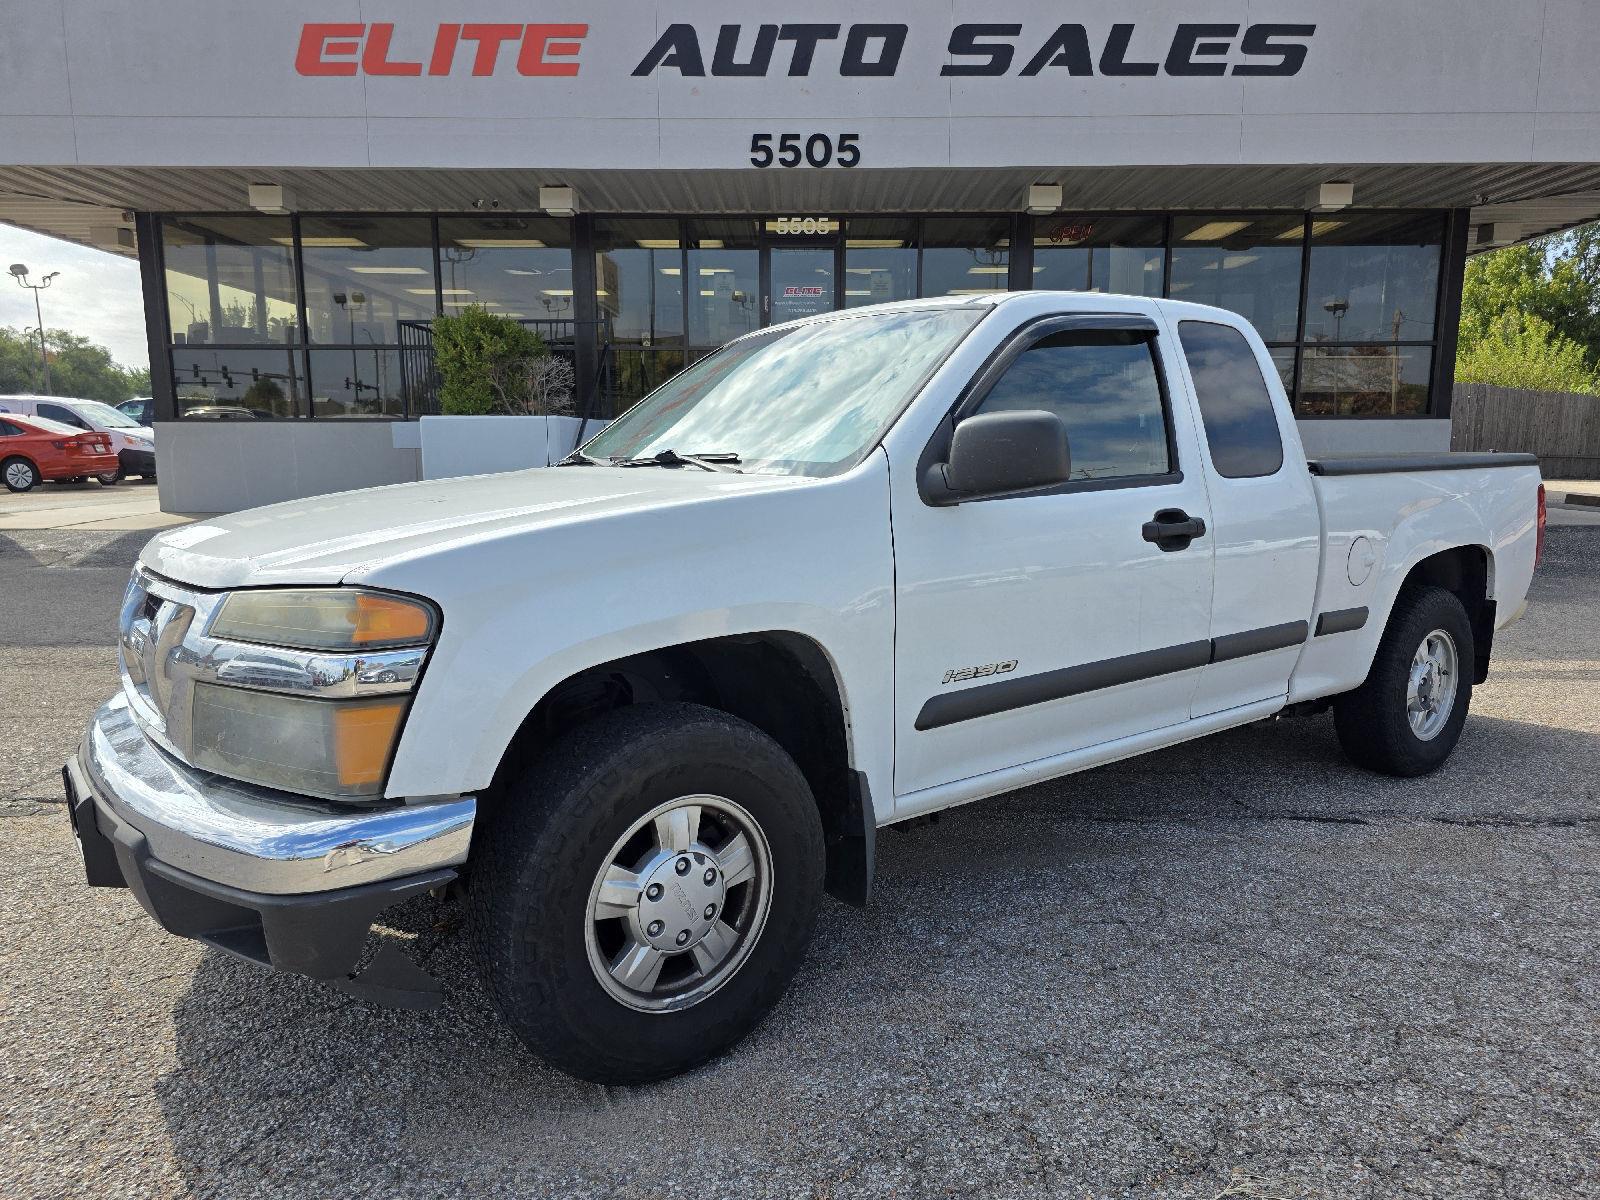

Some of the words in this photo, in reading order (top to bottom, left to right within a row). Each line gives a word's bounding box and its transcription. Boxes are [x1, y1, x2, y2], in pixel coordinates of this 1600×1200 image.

[295, 23, 589, 76] ELITE
[631, 23, 909, 77] AUTO
[940, 23, 1317, 77] SALES
[750, 133, 861, 168] 5505
[776, 217, 830, 235] 5505
[1050, 224, 1094, 243] OPEN
